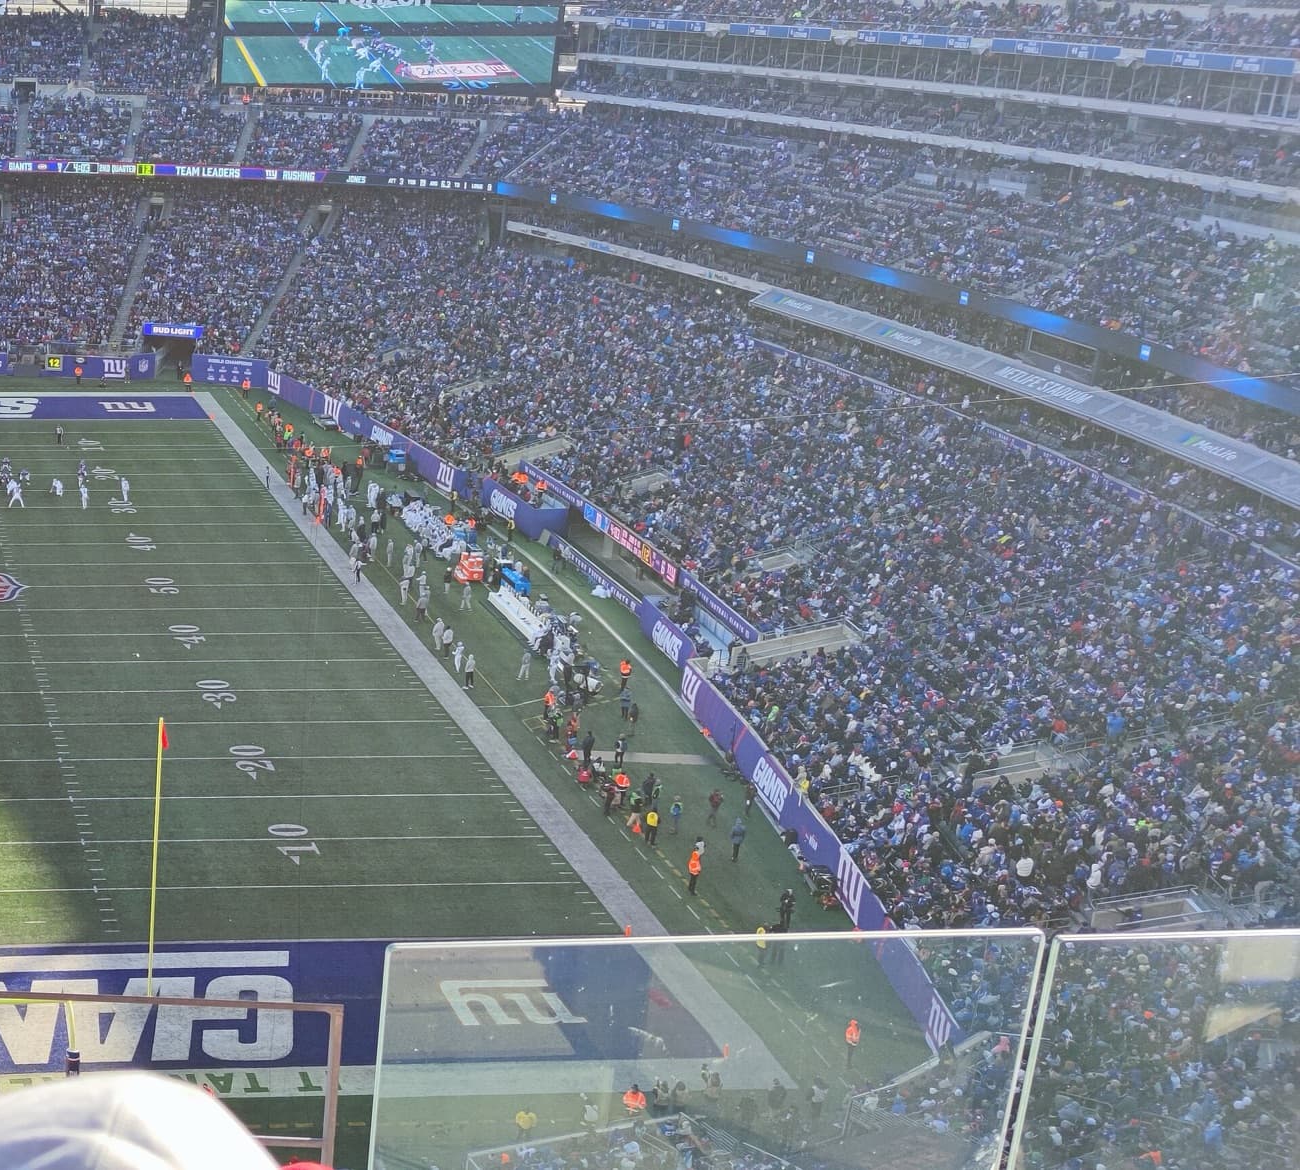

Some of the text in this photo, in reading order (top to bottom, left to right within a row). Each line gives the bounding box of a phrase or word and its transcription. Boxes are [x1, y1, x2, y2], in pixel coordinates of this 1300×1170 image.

[8, 162, 33, 171] GIANTS
[175, 166, 241, 178] TEAM LEADERS
[282, 170, 316, 182] RUSHING
[346, 176, 367, 184] JONES
[153, 326, 195, 336] BUD LIGHT
[48, 358, 60, 368] 12
[98, 401, 157, 413] ny
[1192, 439, 1237, 461] MetLife
[91, 469, 120, 481] 20
[108, 501, 137, 514] 30
[490, 488, 518, 520] GIANTS
[125, 536, 157, 551] 40
[144, 577, 180, 594] 50
[168, 624, 206, 644] 40
[652, 620, 683, 664] GIANTS
[195, 679, 237, 702] 30
[681, 664, 702, 712] ny
[229, 745, 276, 772] 20
[753, 756, 788, 817] GIANTS
[267, 823, 320, 856] 10
[834, 850, 866, 928] ny
[439, 979, 589, 1026] ny
